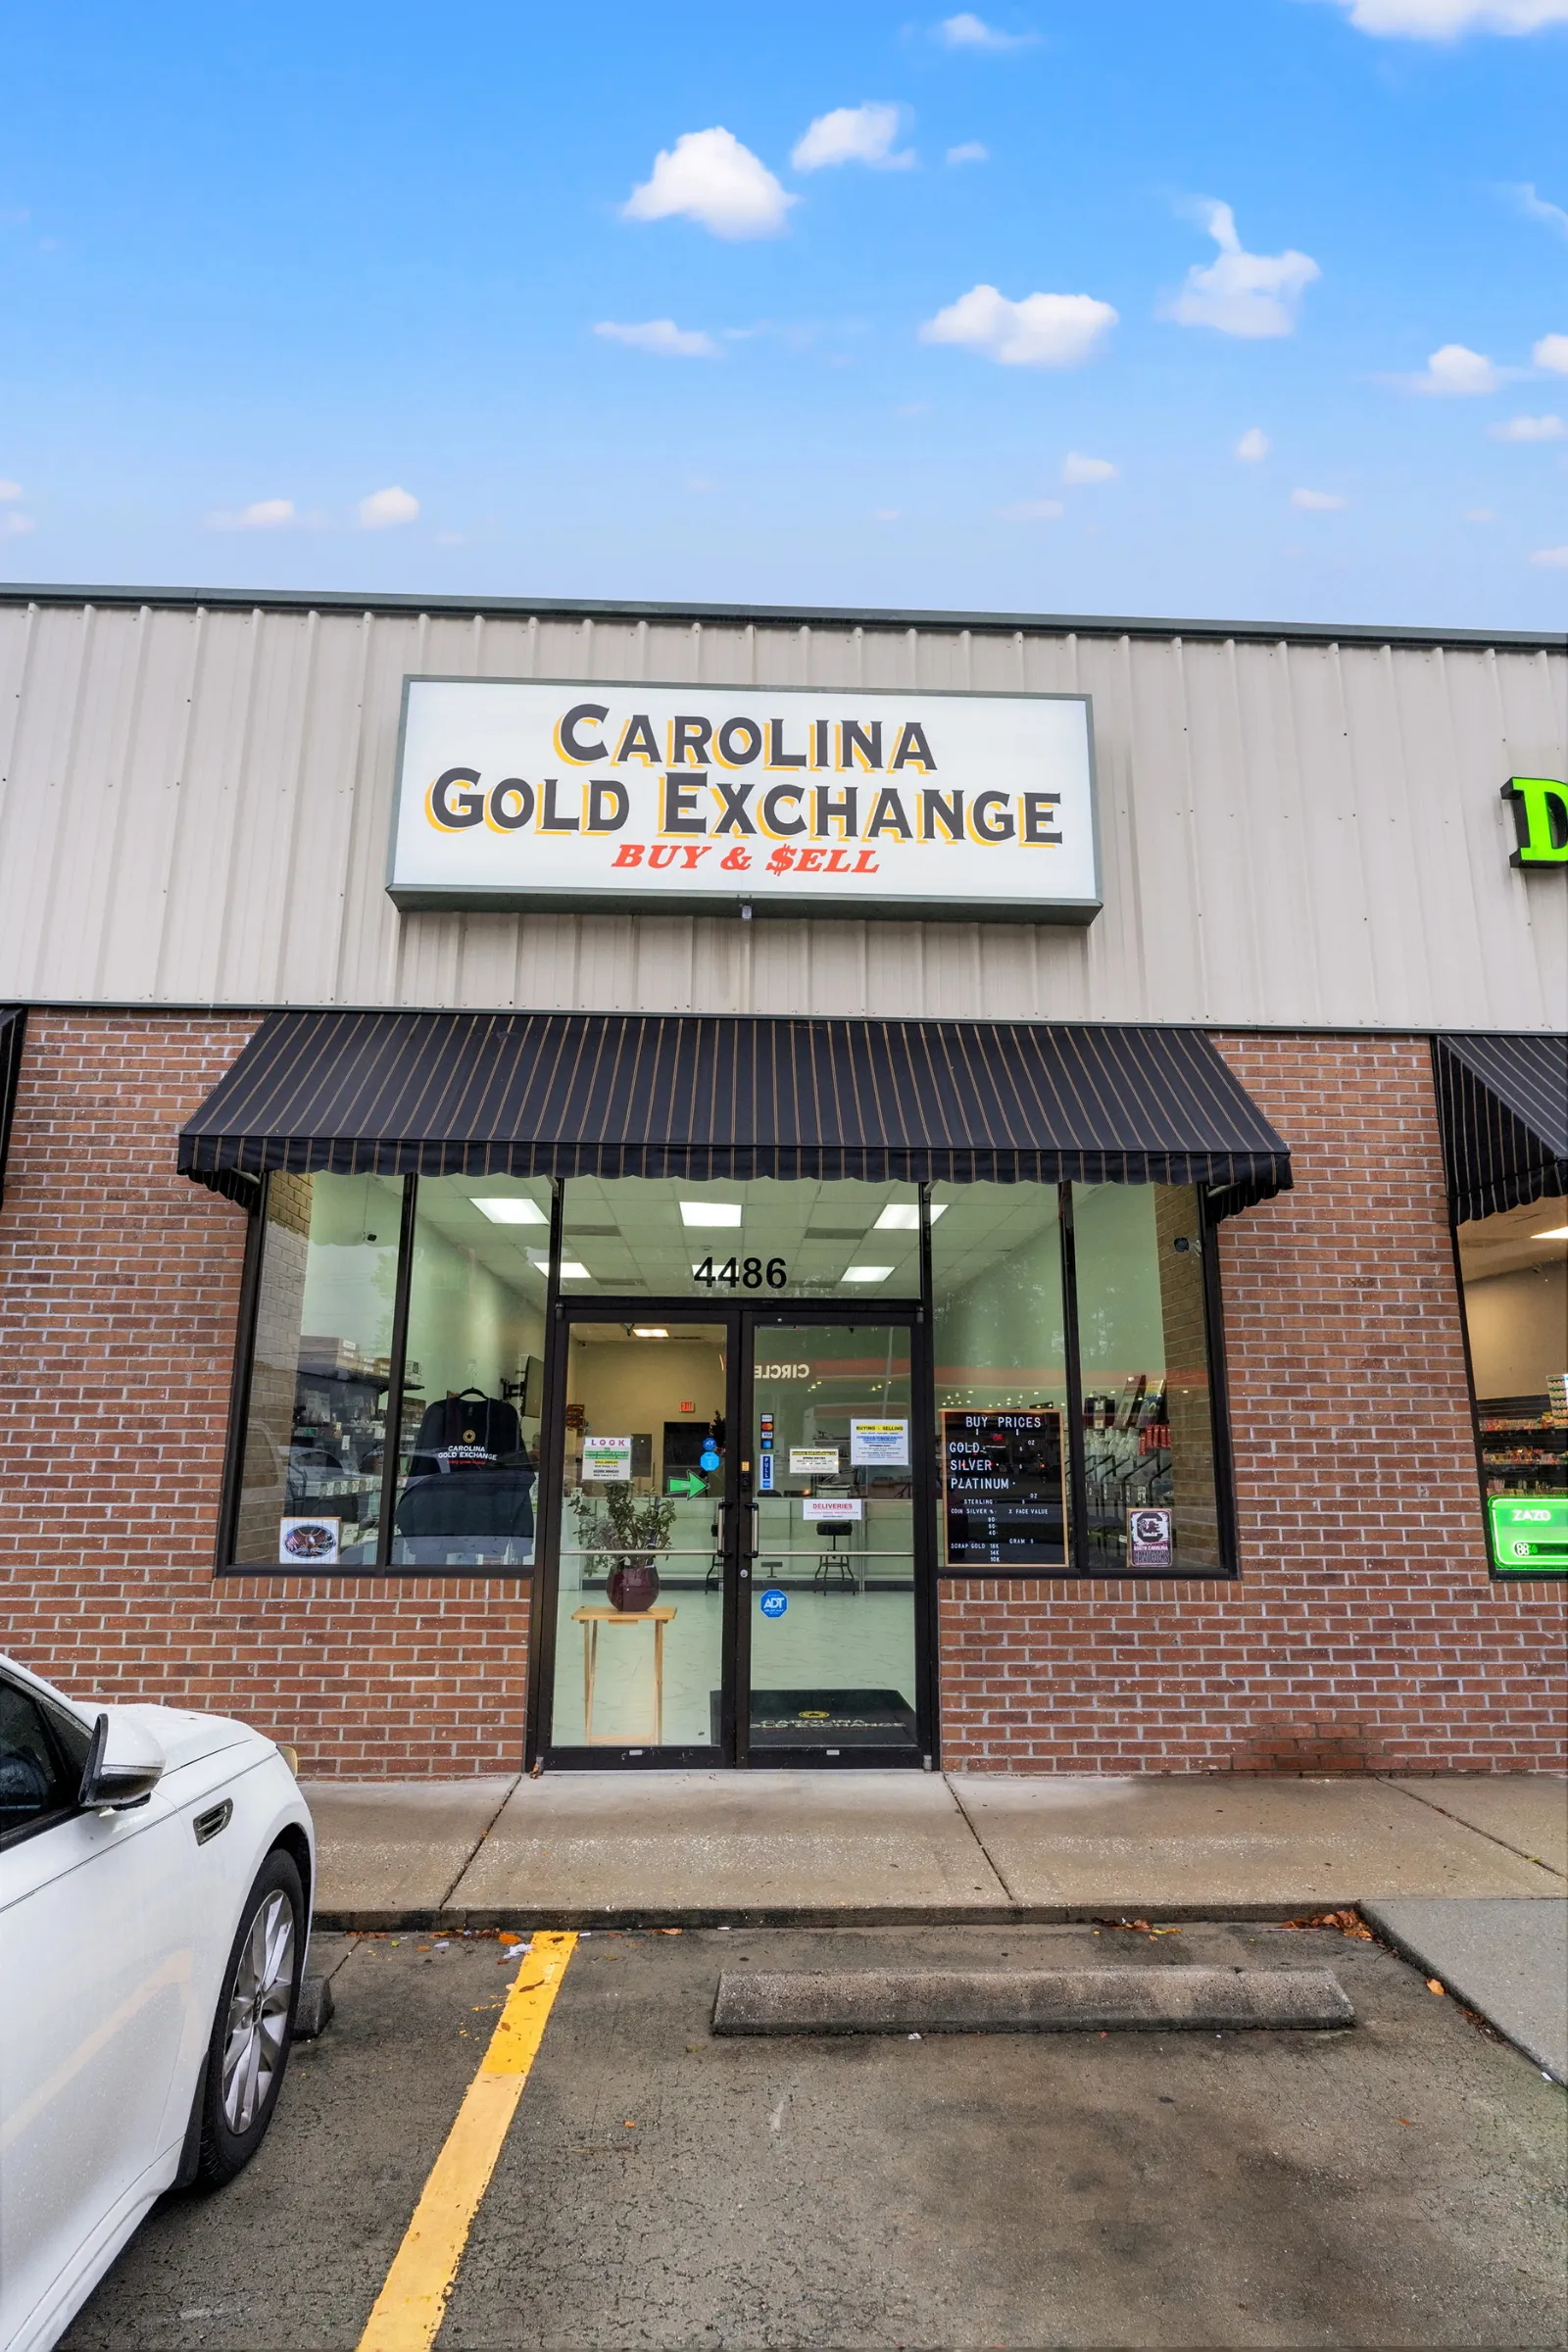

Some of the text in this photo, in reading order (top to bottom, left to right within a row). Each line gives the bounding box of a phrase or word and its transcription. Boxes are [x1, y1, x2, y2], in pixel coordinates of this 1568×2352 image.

[554, 703, 938, 774] CAROLINA
[424, 766, 1063, 848] GOLD EXCHANGE
[612, 844, 711, 869] BUY
[720, 847, 752, 870] &
[693, 1256, 787, 1290] 4486
[680, 1401, 693, 1411] EXIT
[965, 1416, 1042, 1428] BUY PRICES
[949, 1442, 980, 1453] GOLD
[459, 1451, 498, 1461] EXCHANGE
[950, 1459, 992, 1471] SILVER
[951, 1478, 1009, 1489] PLATINUM
[763, 1597, 785, 1608] ADT
